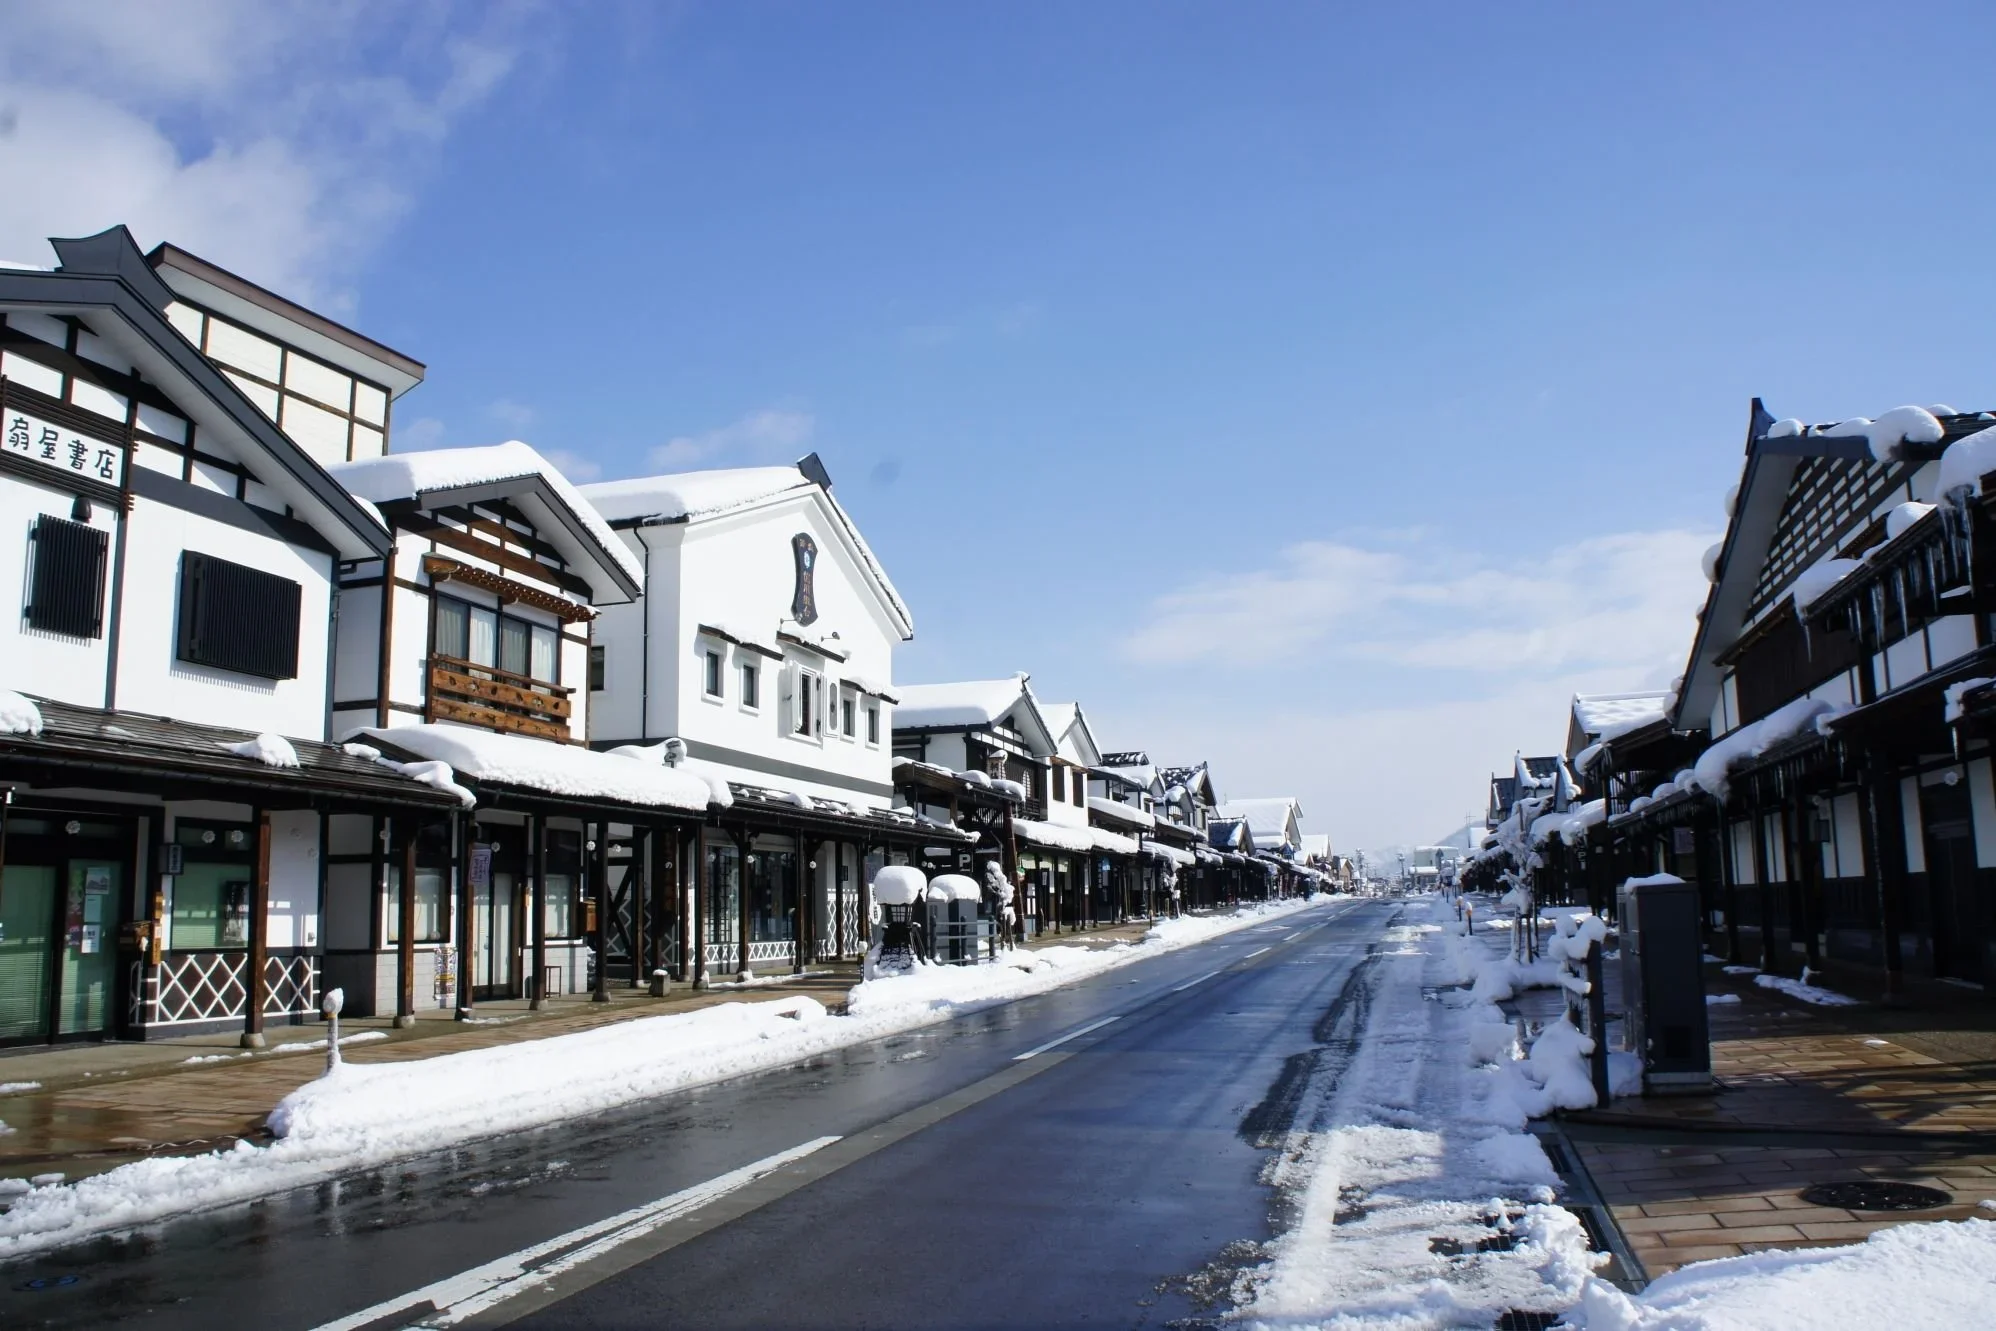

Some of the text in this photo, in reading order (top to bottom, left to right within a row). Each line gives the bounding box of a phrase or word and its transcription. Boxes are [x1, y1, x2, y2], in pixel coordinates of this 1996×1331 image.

[9, 417, 116, 480] 扇屋書店
[959, 854, 971, 867] P
